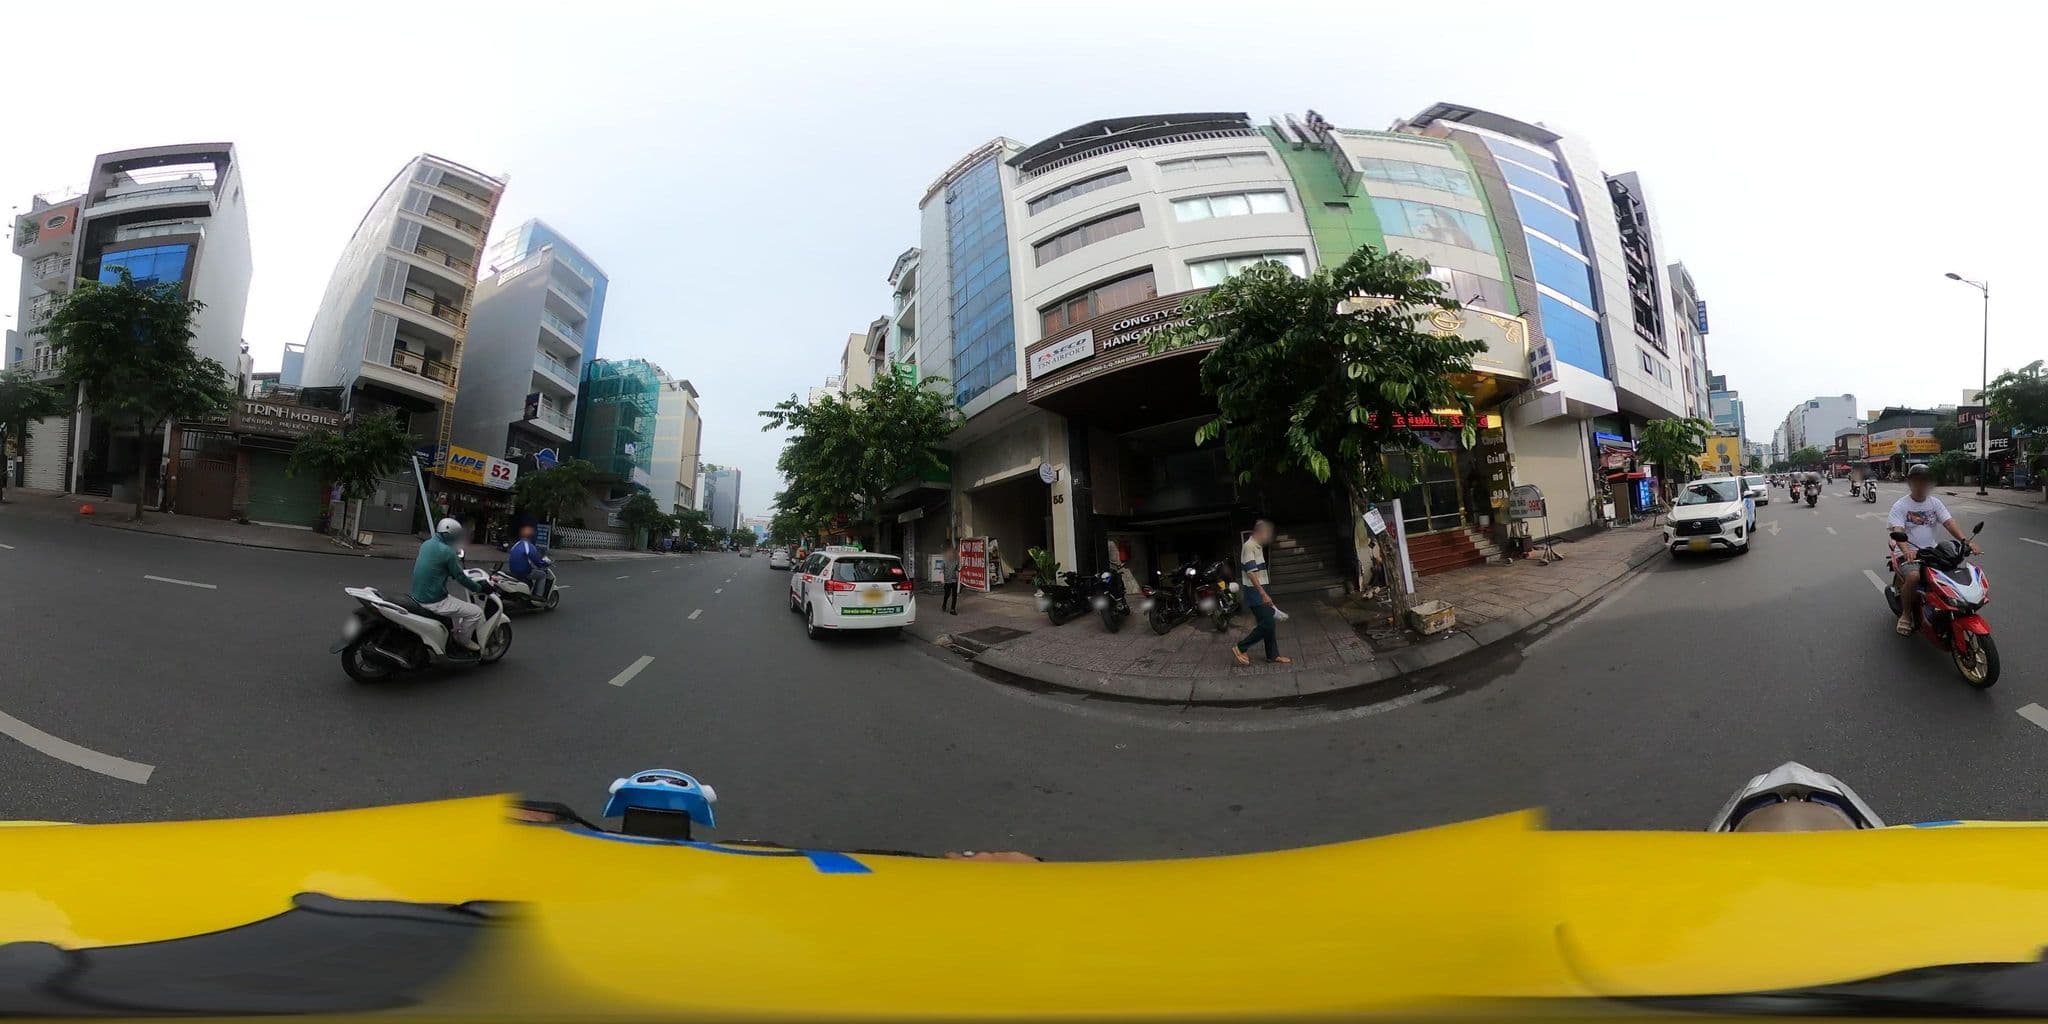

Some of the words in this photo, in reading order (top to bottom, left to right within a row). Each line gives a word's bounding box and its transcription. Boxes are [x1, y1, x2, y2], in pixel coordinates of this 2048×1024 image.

[290, 410, 339, 426] MOBILE
[450, 454, 486, 470] MPE
[491, 464, 511, 480] 52
